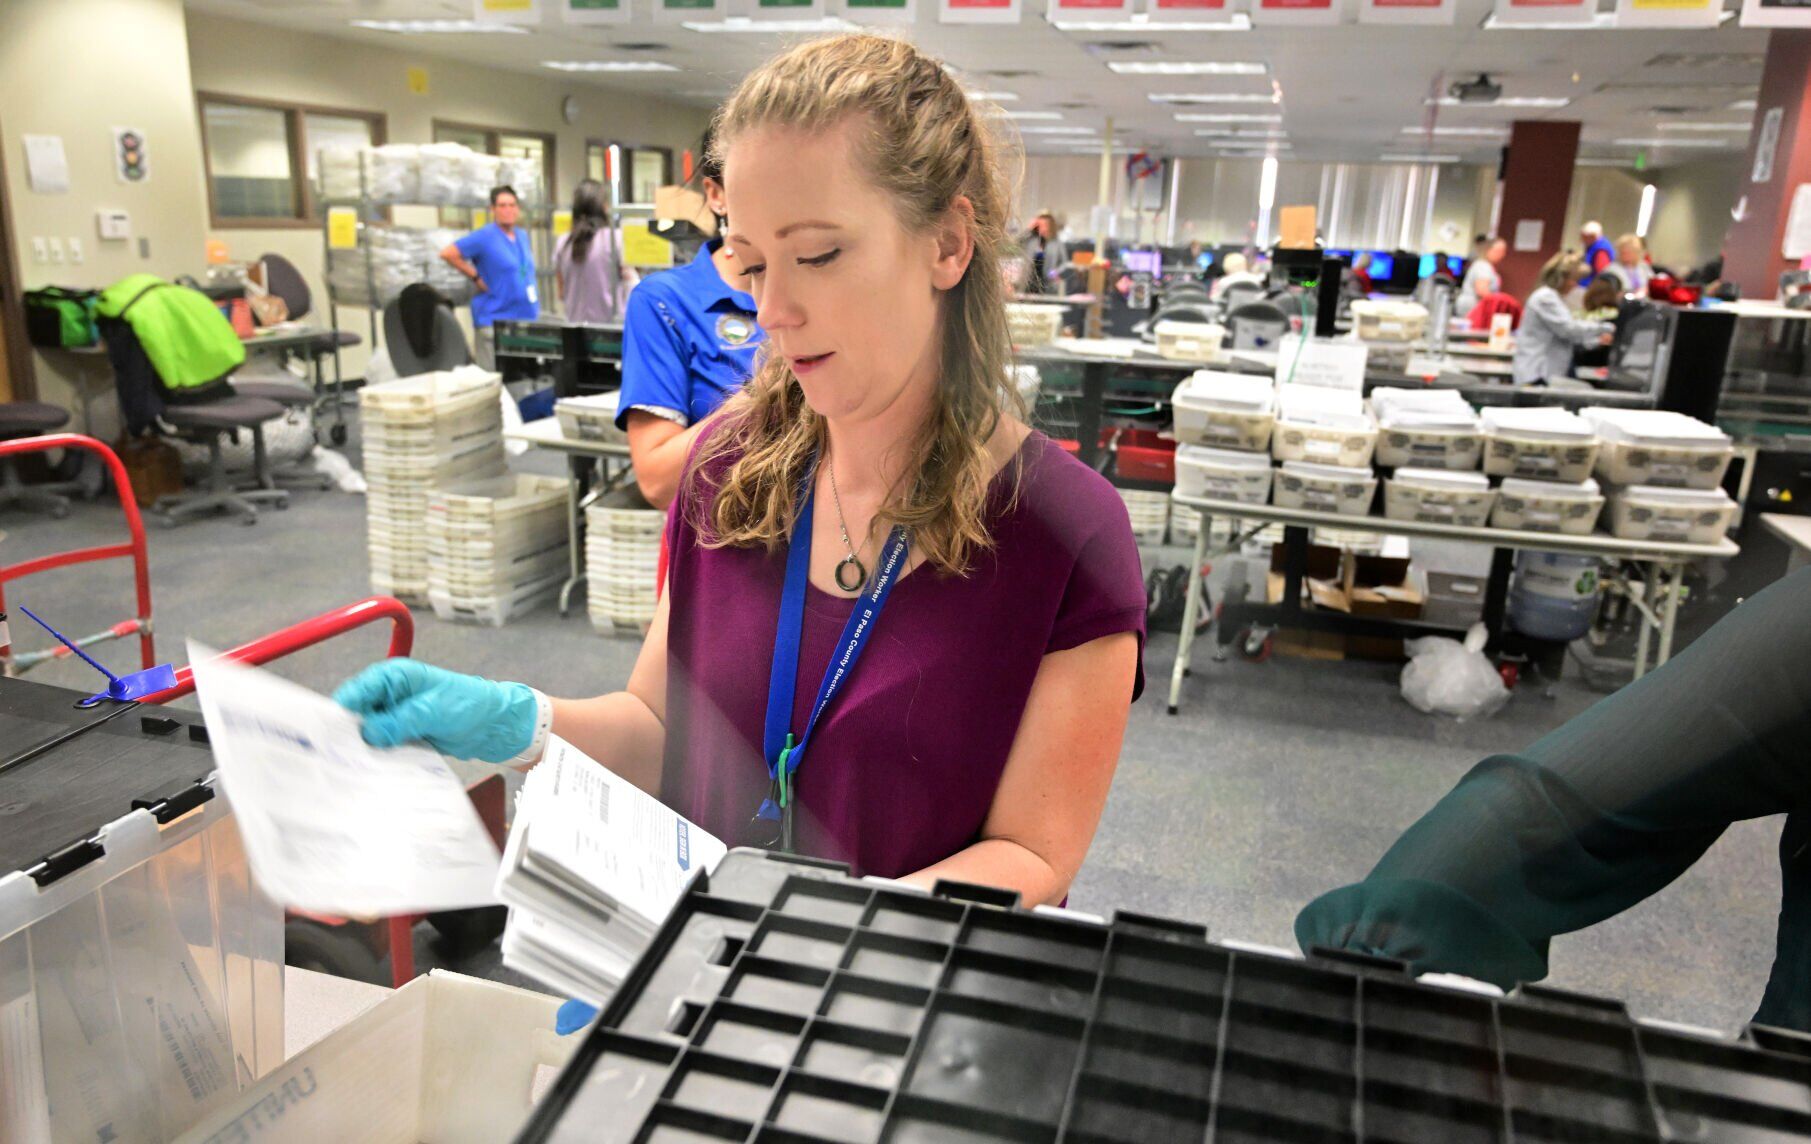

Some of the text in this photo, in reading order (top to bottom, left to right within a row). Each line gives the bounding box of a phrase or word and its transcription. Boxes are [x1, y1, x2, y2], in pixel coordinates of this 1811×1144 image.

[871, 542, 904, 603] Election Worker
[863, 609, 873, 619] El
[854, 618, 868, 639] Paso
[840, 639, 858, 667] County
[825, 667, 844, 698] Election
